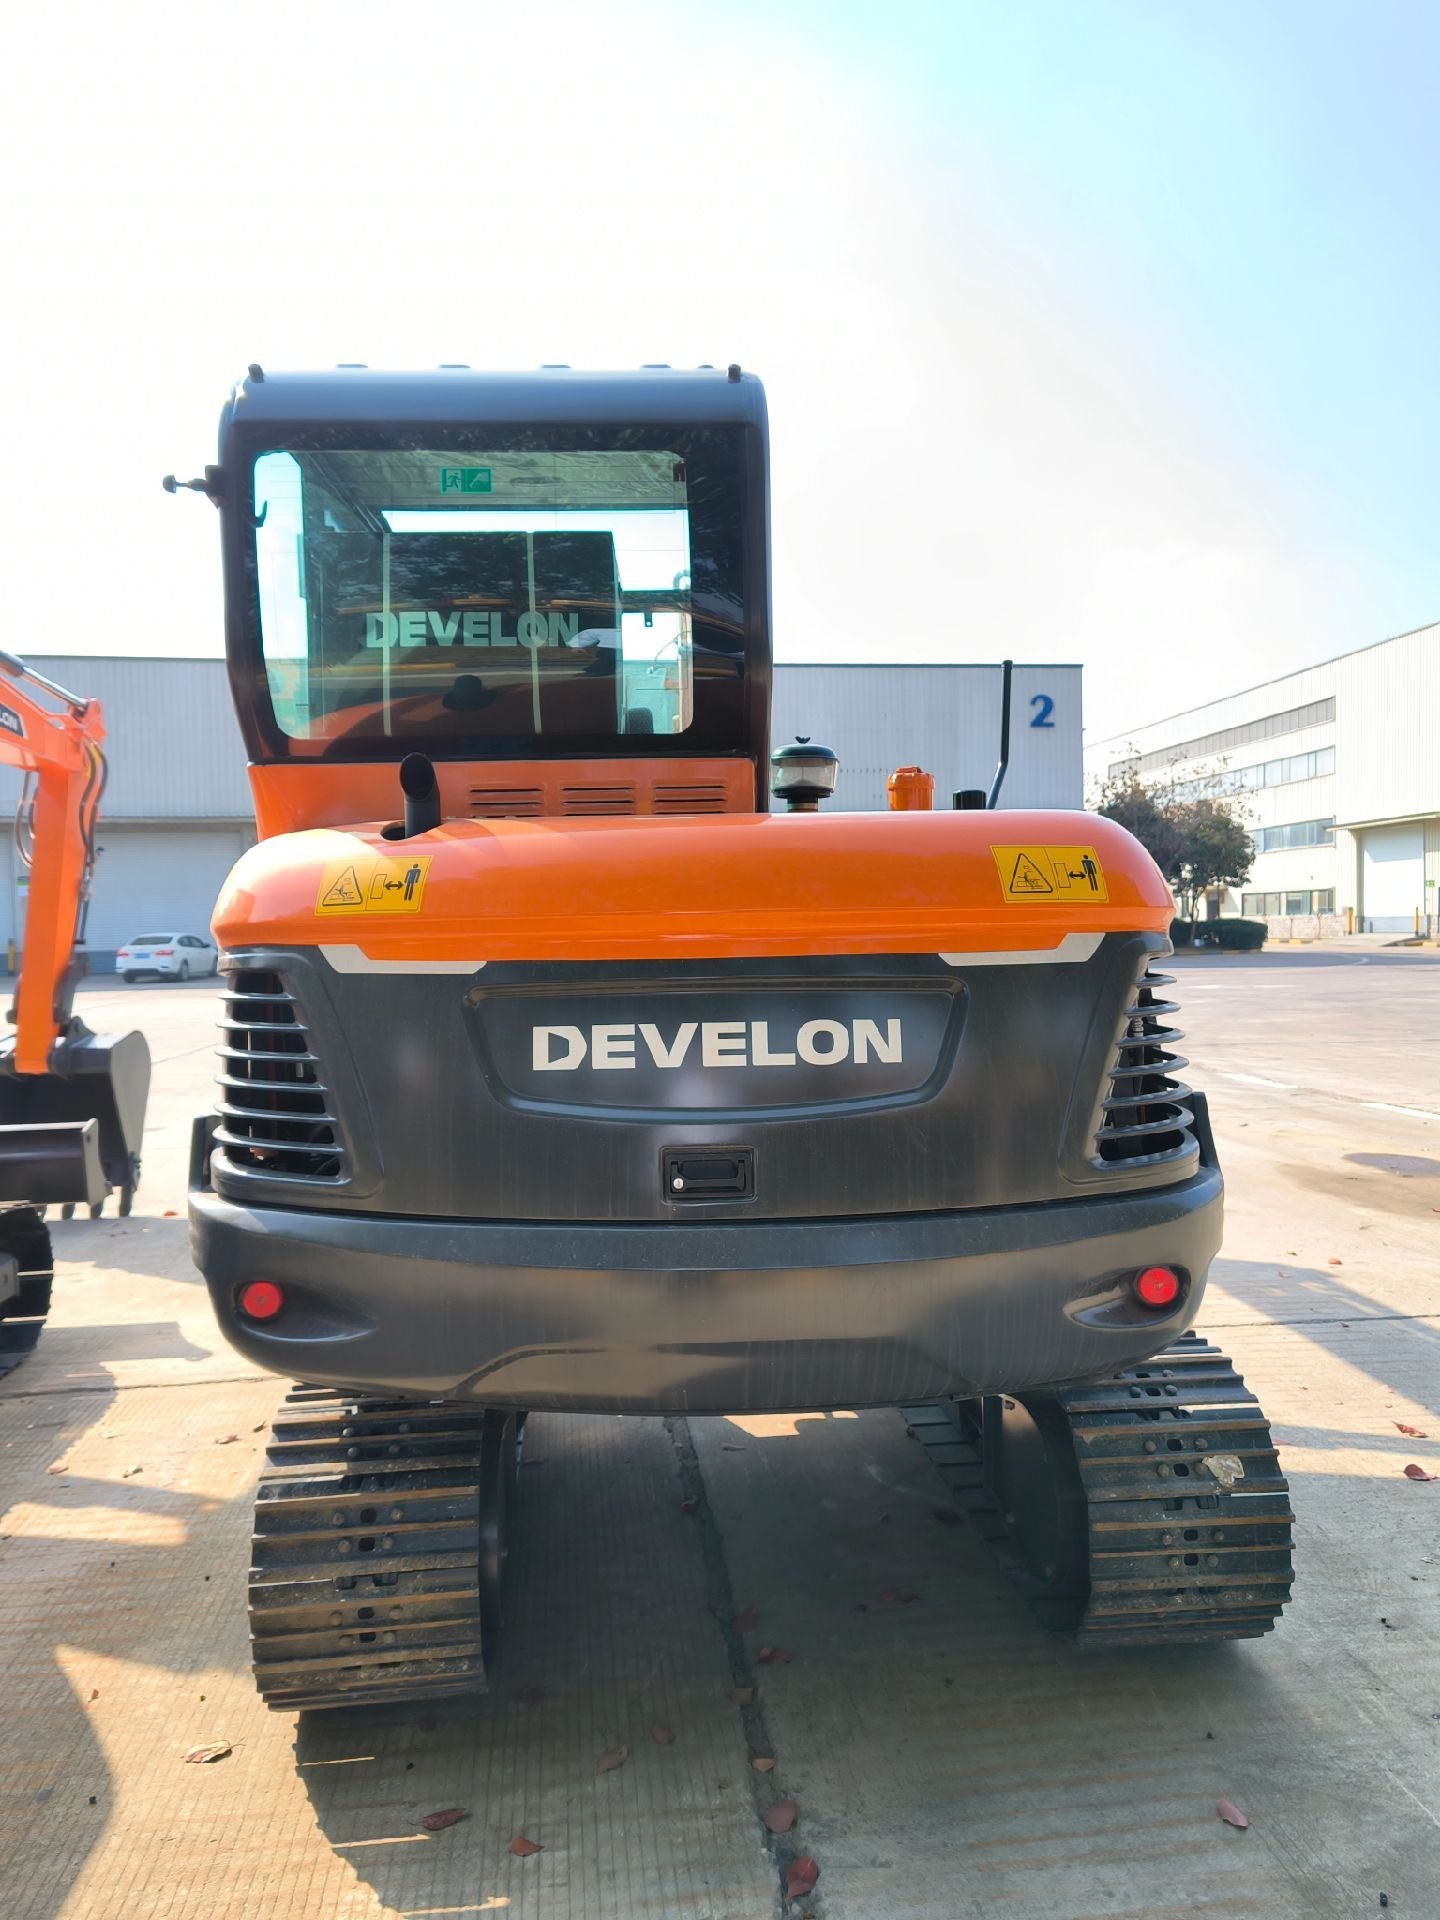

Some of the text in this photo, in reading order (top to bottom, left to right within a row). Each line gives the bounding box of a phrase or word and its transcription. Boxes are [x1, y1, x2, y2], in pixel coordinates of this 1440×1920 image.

[366, 611, 579, 648] DEVELON
[1030, 694, 1055, 728] 2
[532, 1018, 903, 1071] DEVELON
